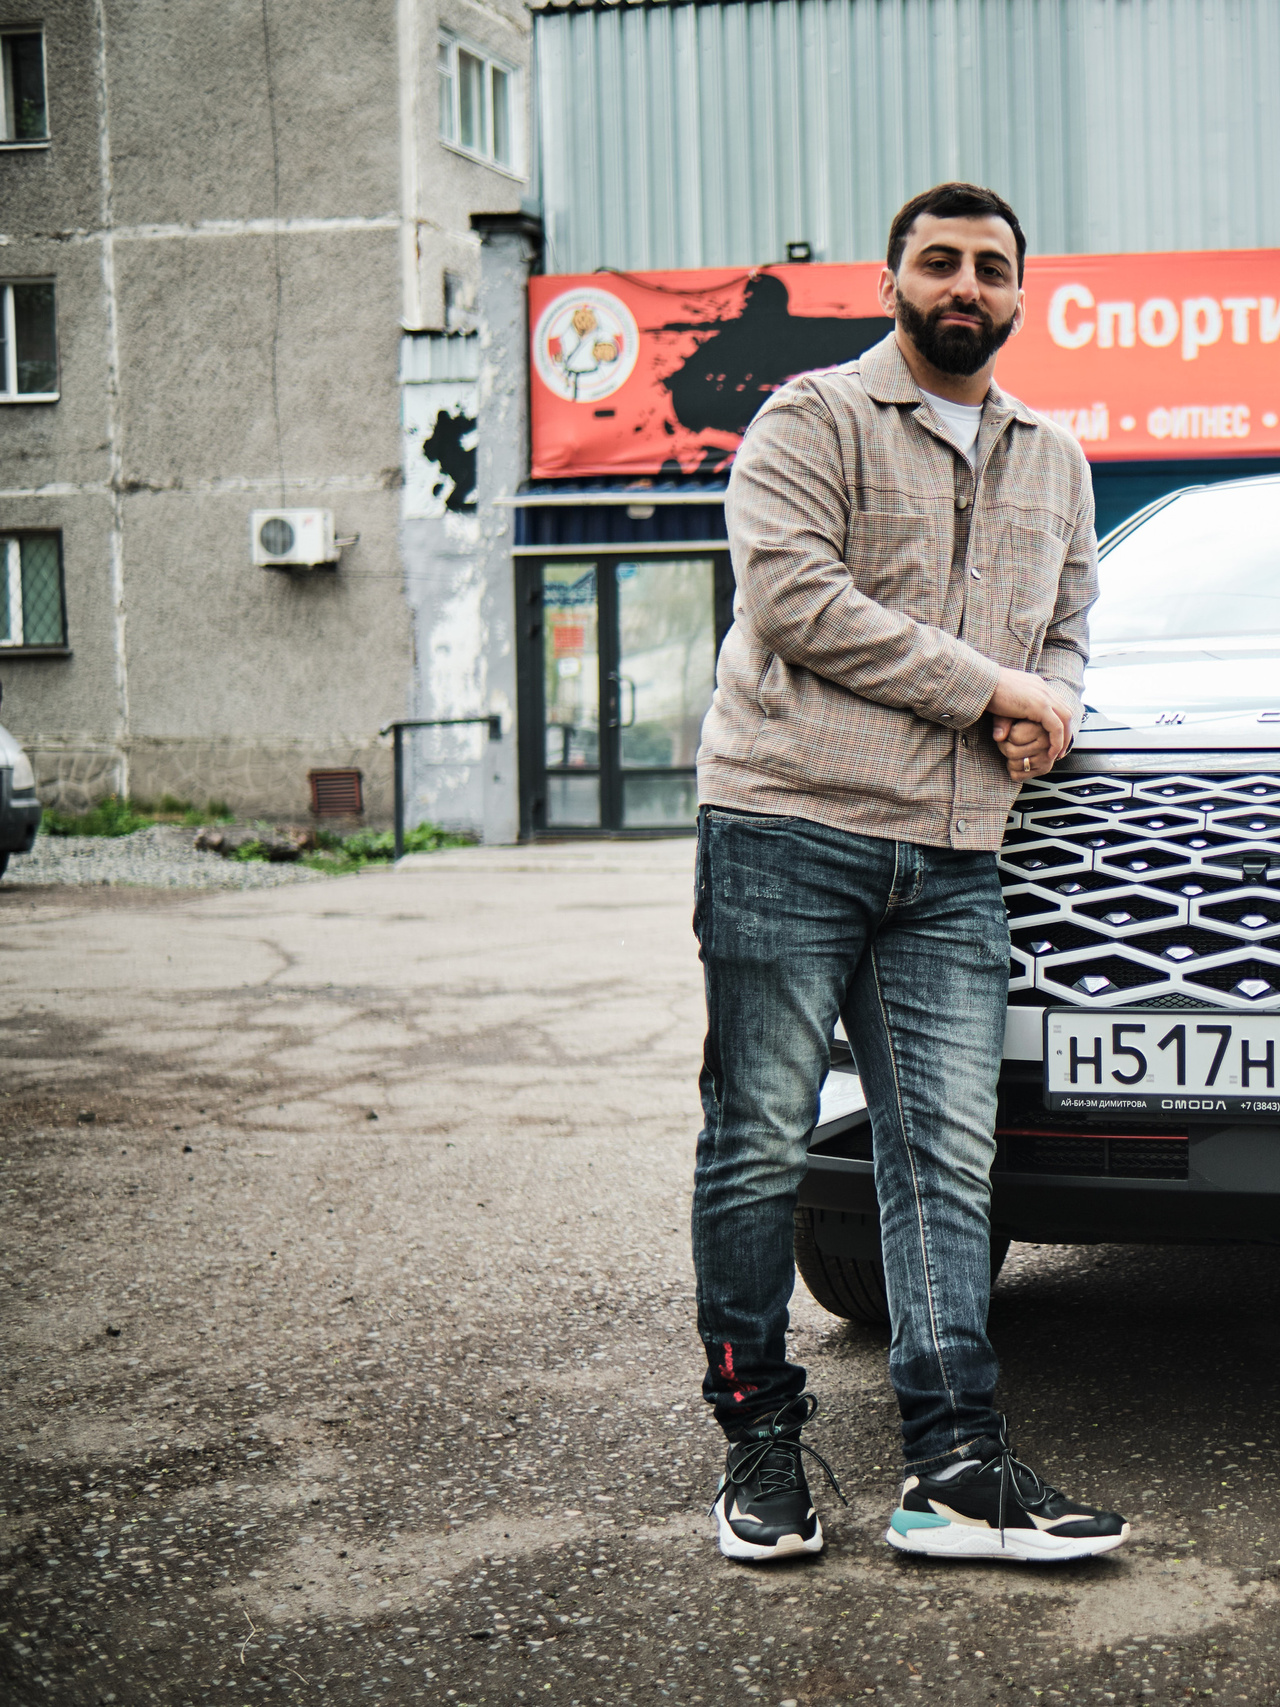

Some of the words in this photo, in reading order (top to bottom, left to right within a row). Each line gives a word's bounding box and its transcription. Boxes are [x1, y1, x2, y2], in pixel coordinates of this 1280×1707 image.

[1146, 405, 1251, 440] ФИТНЕС
[1060, 1098, 1098, 1107] АЙ-БИ-ЭМ
[1099, 1099, 1147, 1109] ДИМИТРОВА
[1240, 1101, 1252, 1110] +7
[1253, 1101, 1280, 1112] (3843)
